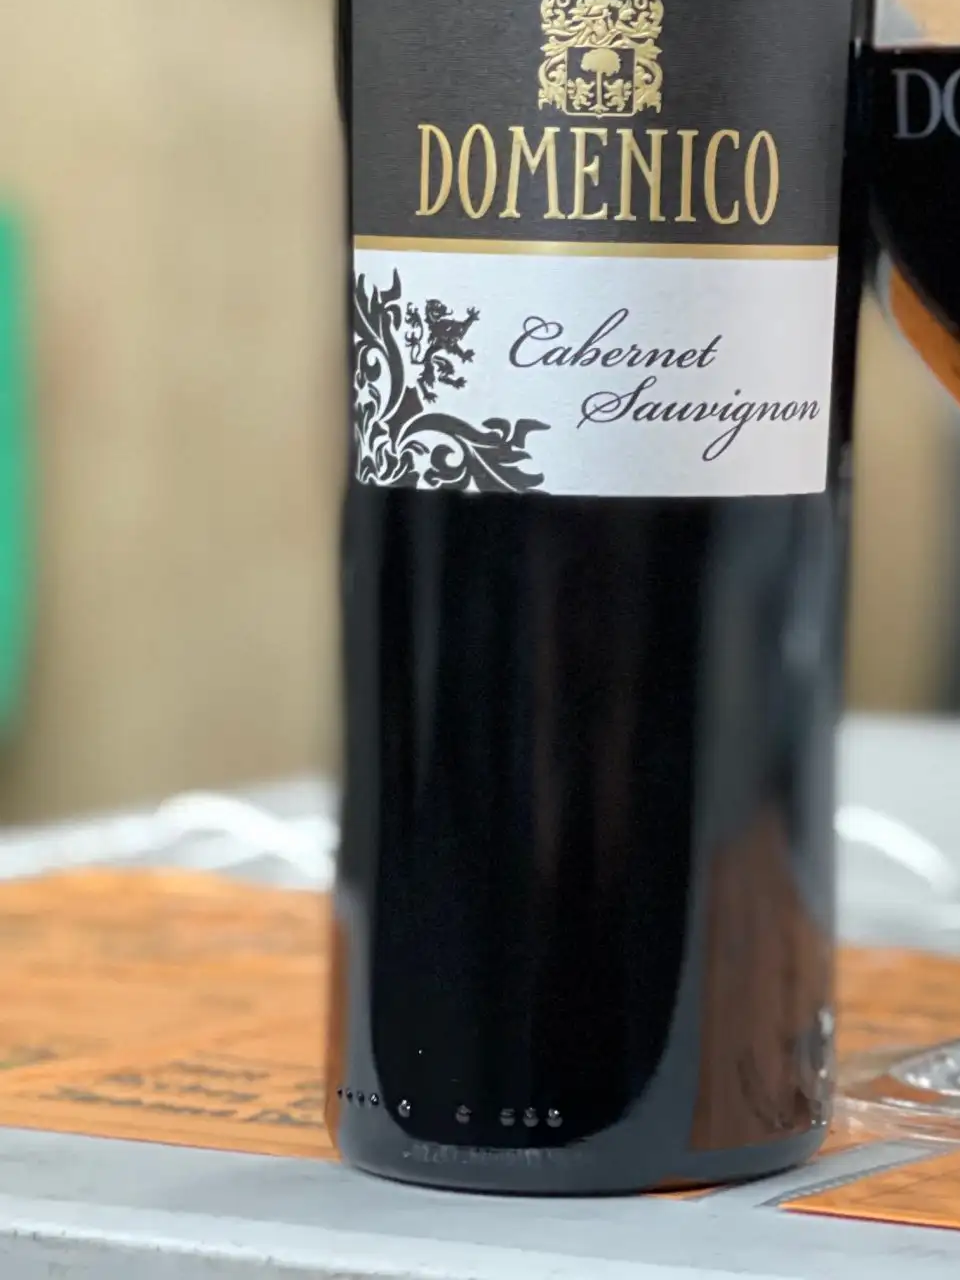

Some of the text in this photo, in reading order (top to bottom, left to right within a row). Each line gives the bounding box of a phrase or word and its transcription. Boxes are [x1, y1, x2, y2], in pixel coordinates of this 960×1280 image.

[415, 123, 780, 225] DOMENICO
[508, 308, 723, 369] Cabernet
[576, 376, 821, 461] Sauvignon
